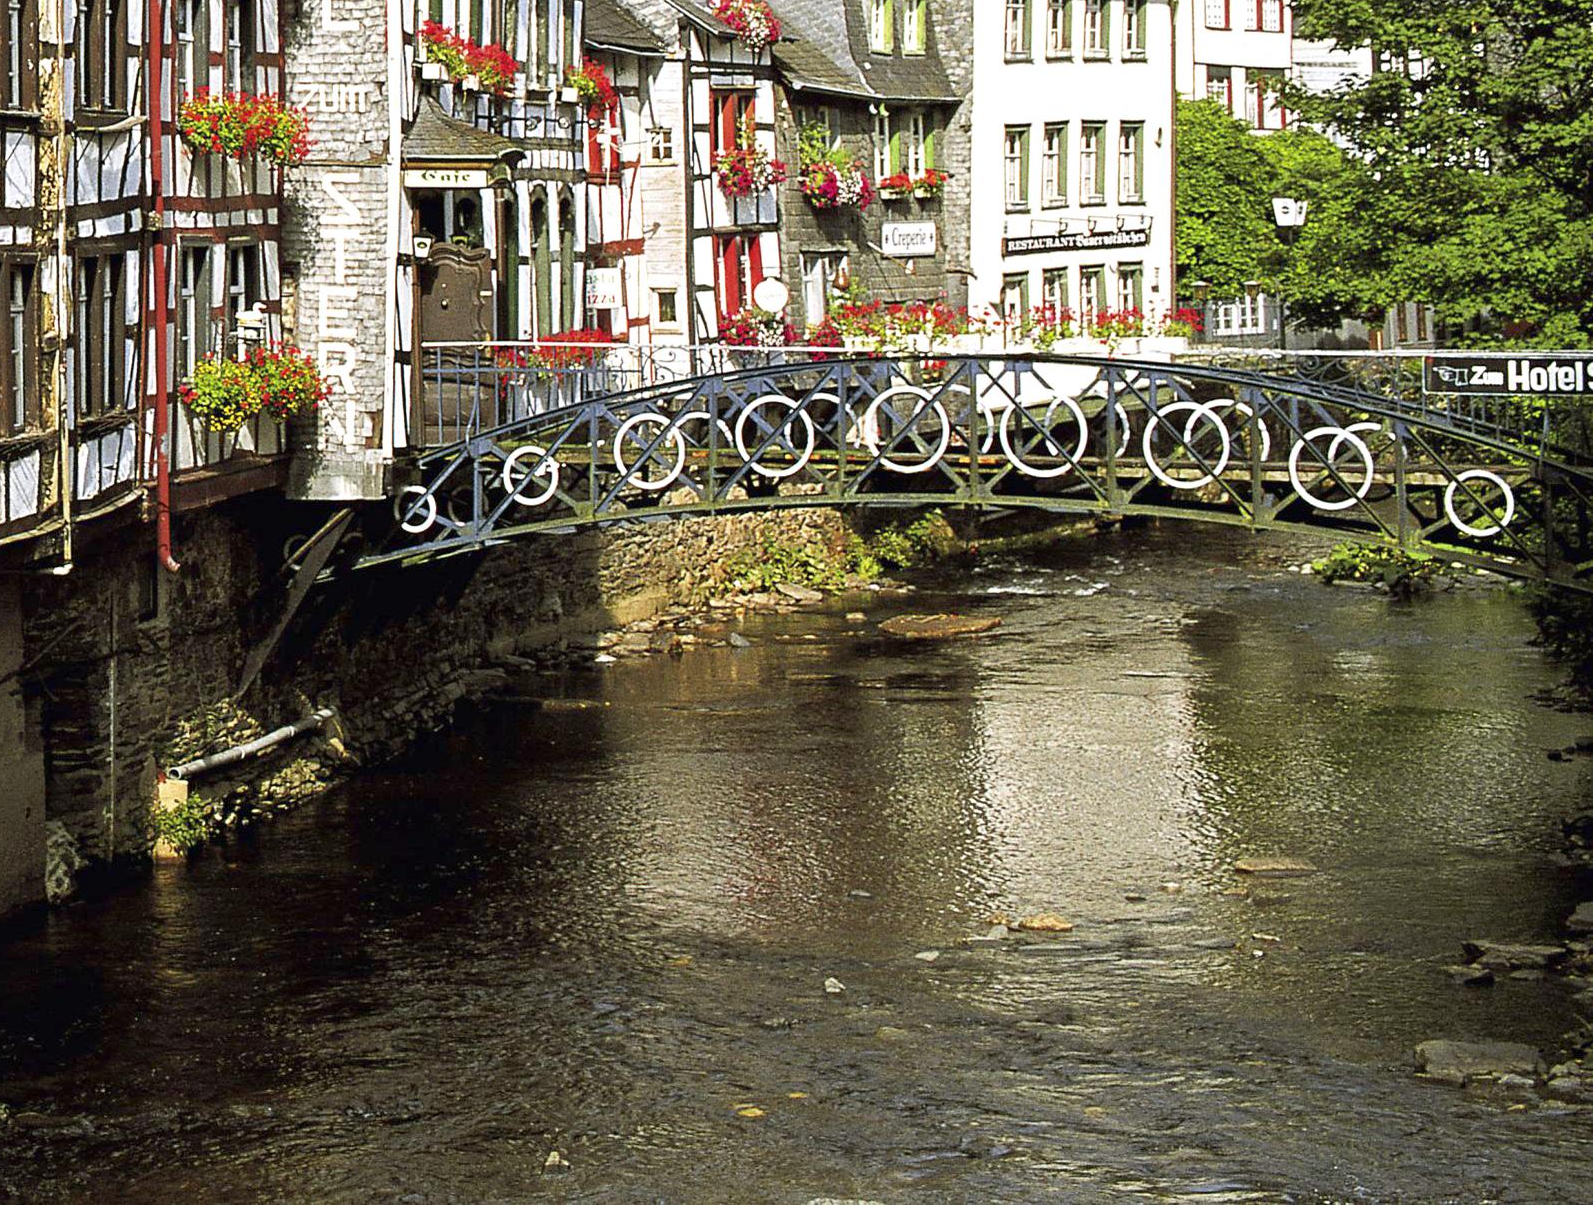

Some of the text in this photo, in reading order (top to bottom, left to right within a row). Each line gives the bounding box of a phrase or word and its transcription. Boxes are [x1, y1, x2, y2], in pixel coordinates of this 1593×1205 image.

[1007, 236, 1076, 252] RESTAURANT
[318, 172, 360, 451] STERN
[1507, 360, 1584, 392] Hotel
